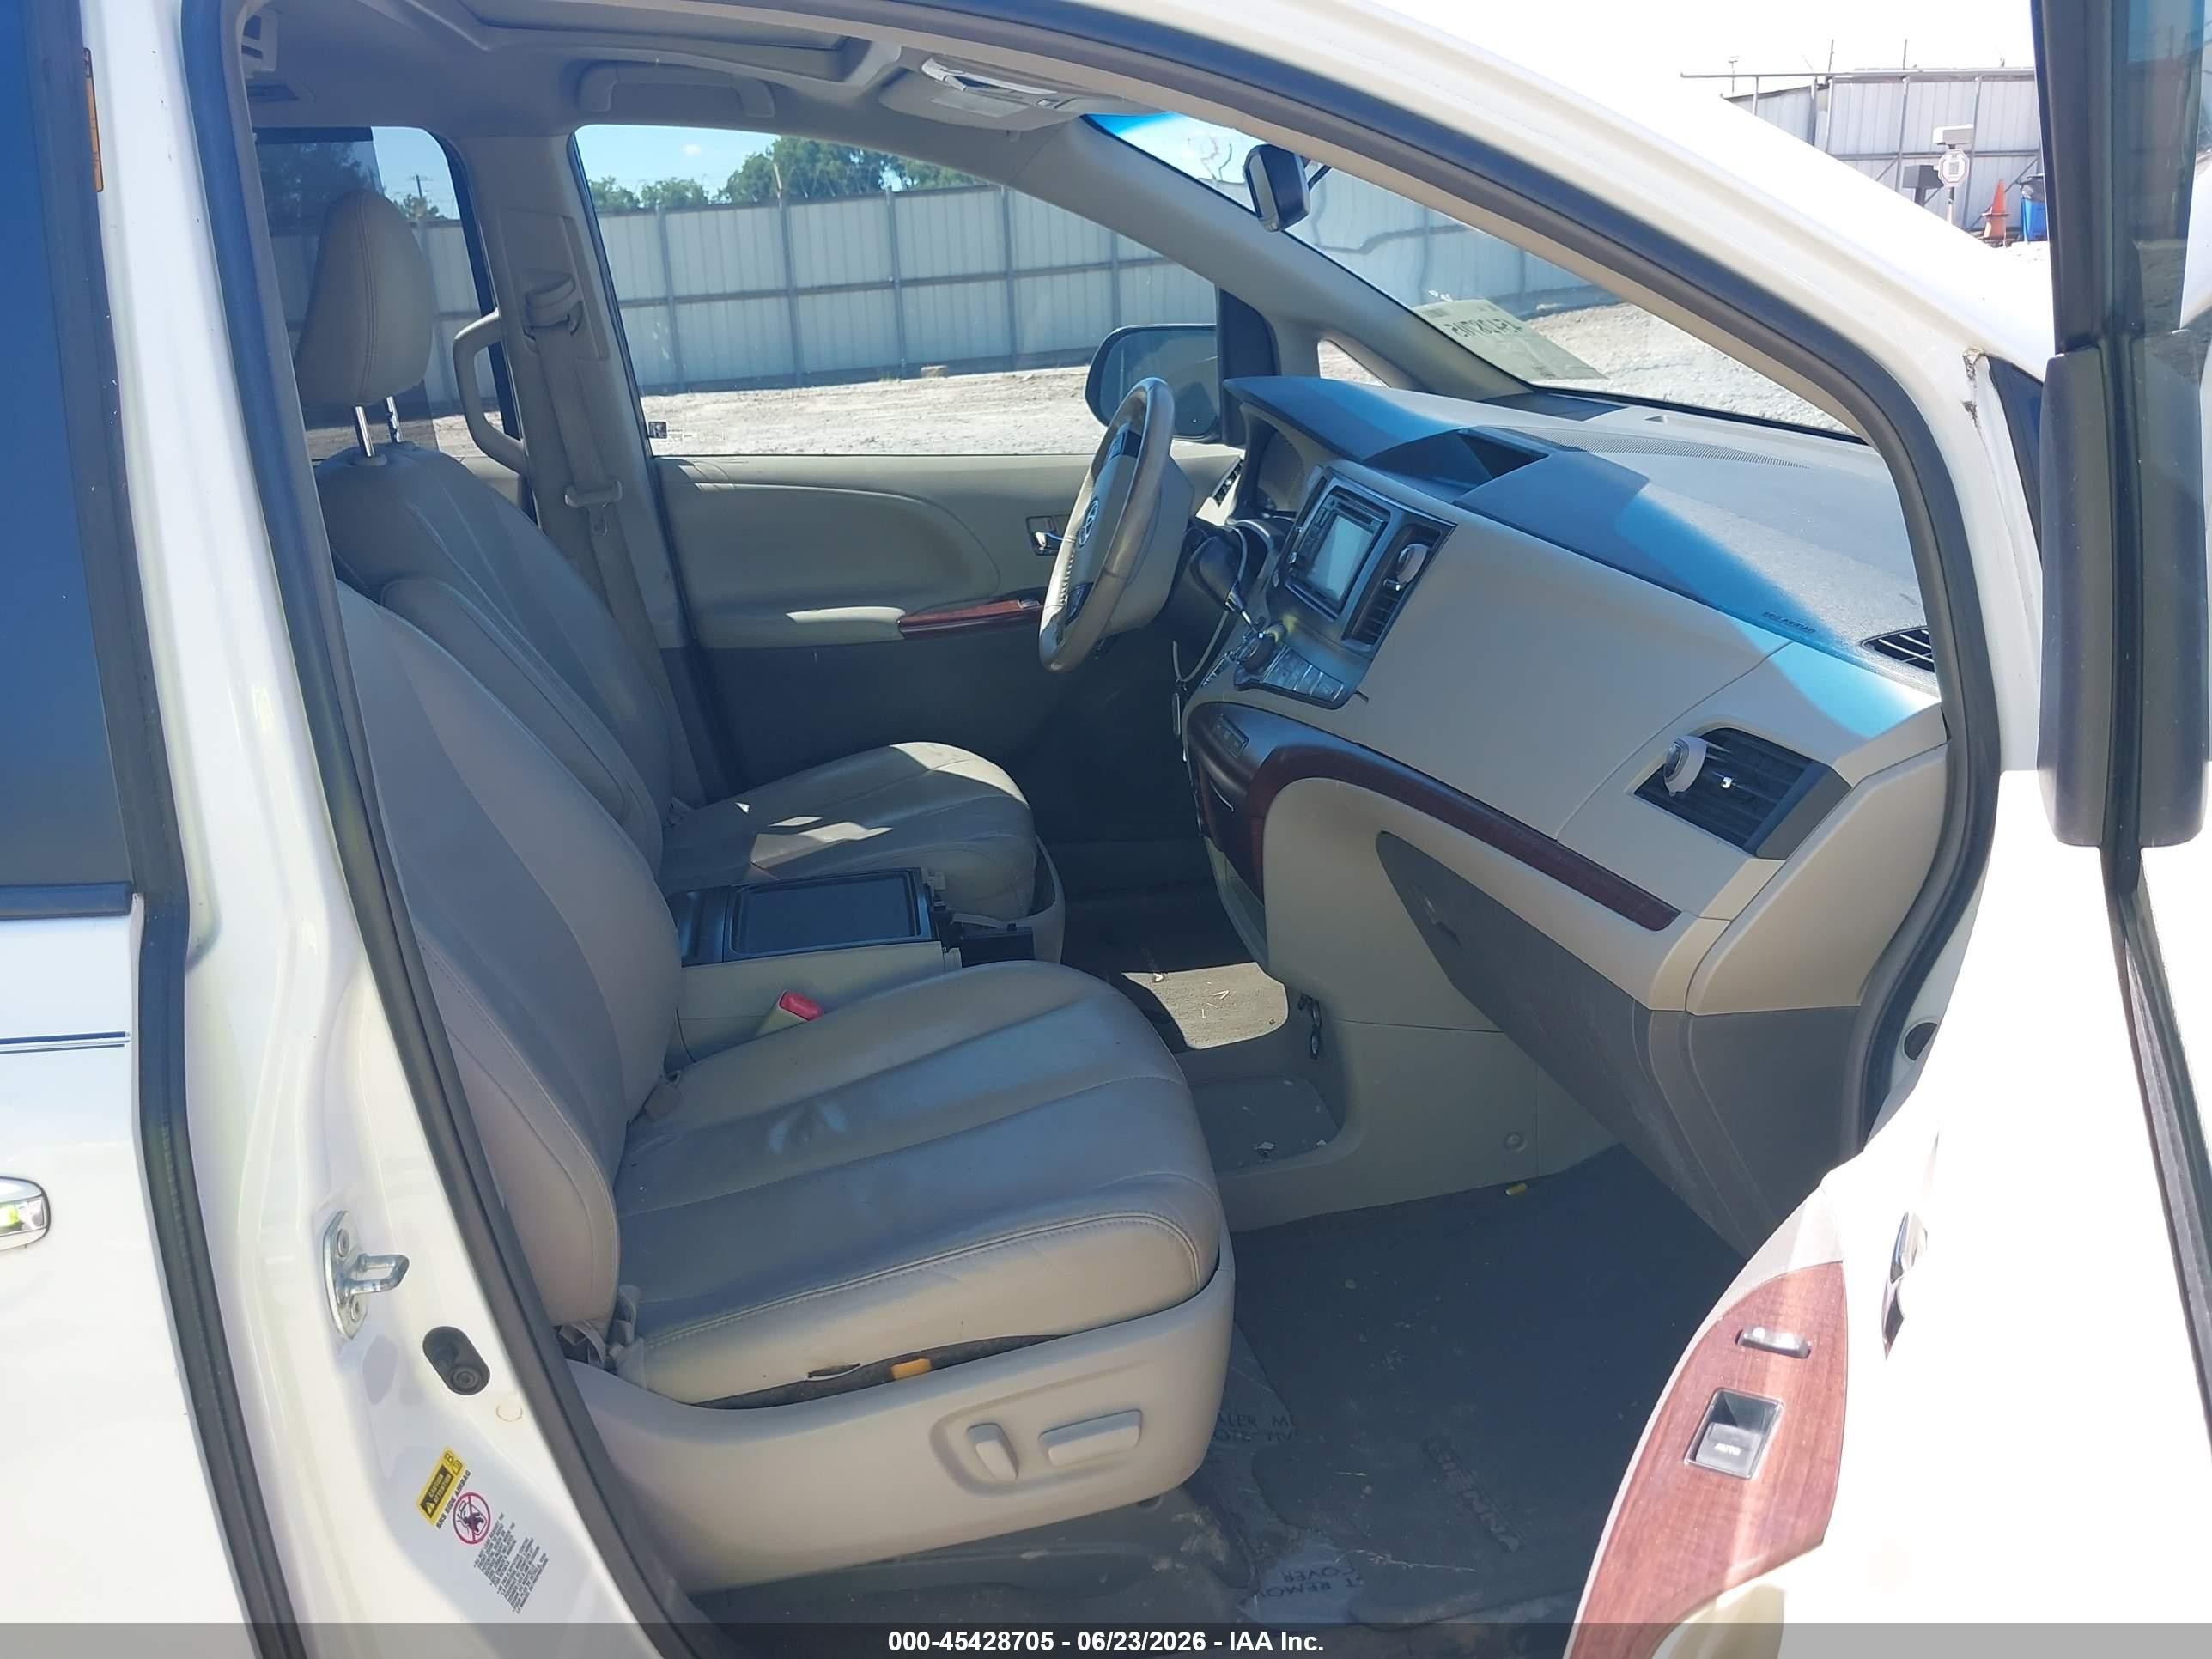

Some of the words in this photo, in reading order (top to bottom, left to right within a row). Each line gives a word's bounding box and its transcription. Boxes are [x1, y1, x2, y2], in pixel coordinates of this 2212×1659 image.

[1714, 1443, 1741, 1455] AUTO
[445, 1496, 456, 1514] SIDE
[454, 1469, 471, 1496] AIRBAG
[1282, 1566, 1355, 1582] COVER
